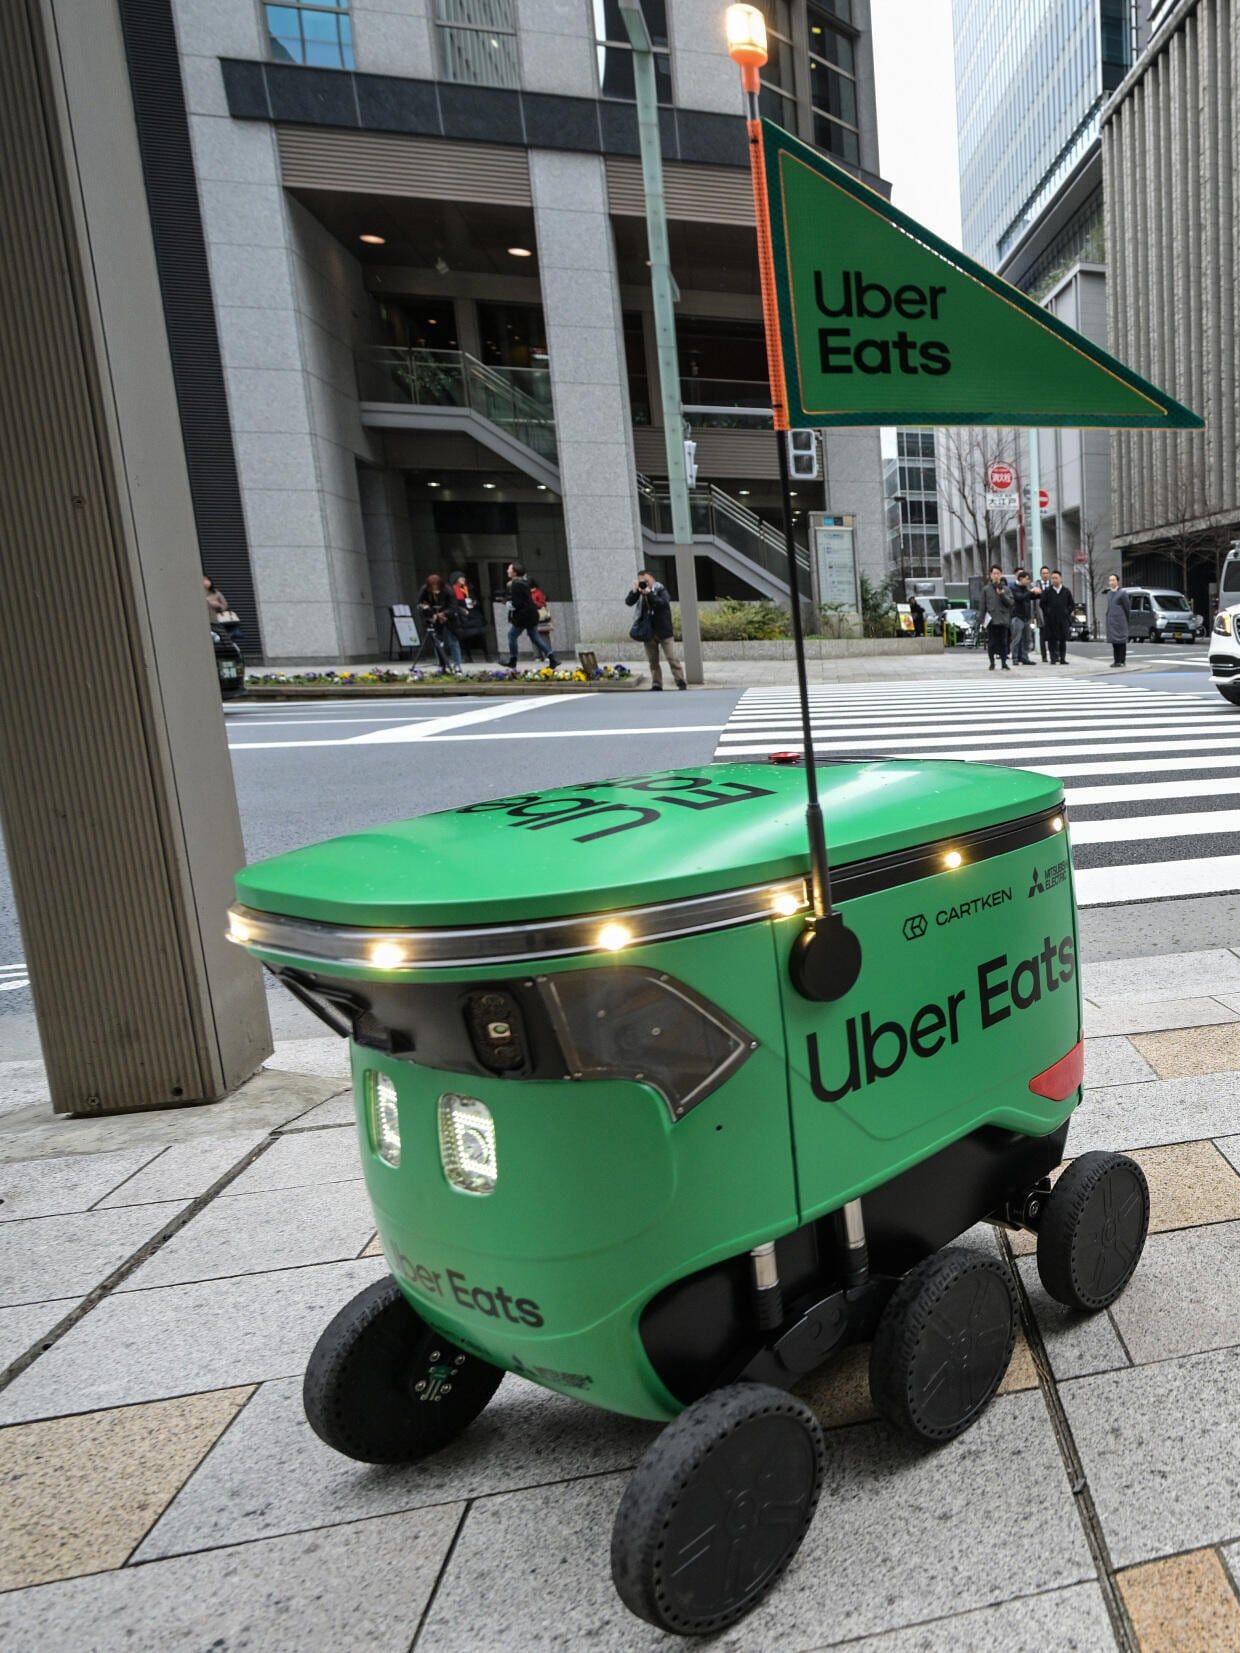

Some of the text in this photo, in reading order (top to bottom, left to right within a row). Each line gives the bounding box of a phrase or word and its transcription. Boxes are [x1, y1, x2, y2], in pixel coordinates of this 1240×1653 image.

[813, 270, 947, 320] Uber
[818, 328, 951, 376] Eats
[935, 887, 1012, 926] CARTKEN
[806, 935, 1075, 1103] Uber Eats
[389, 1240, 545, 1329] ber Eats
